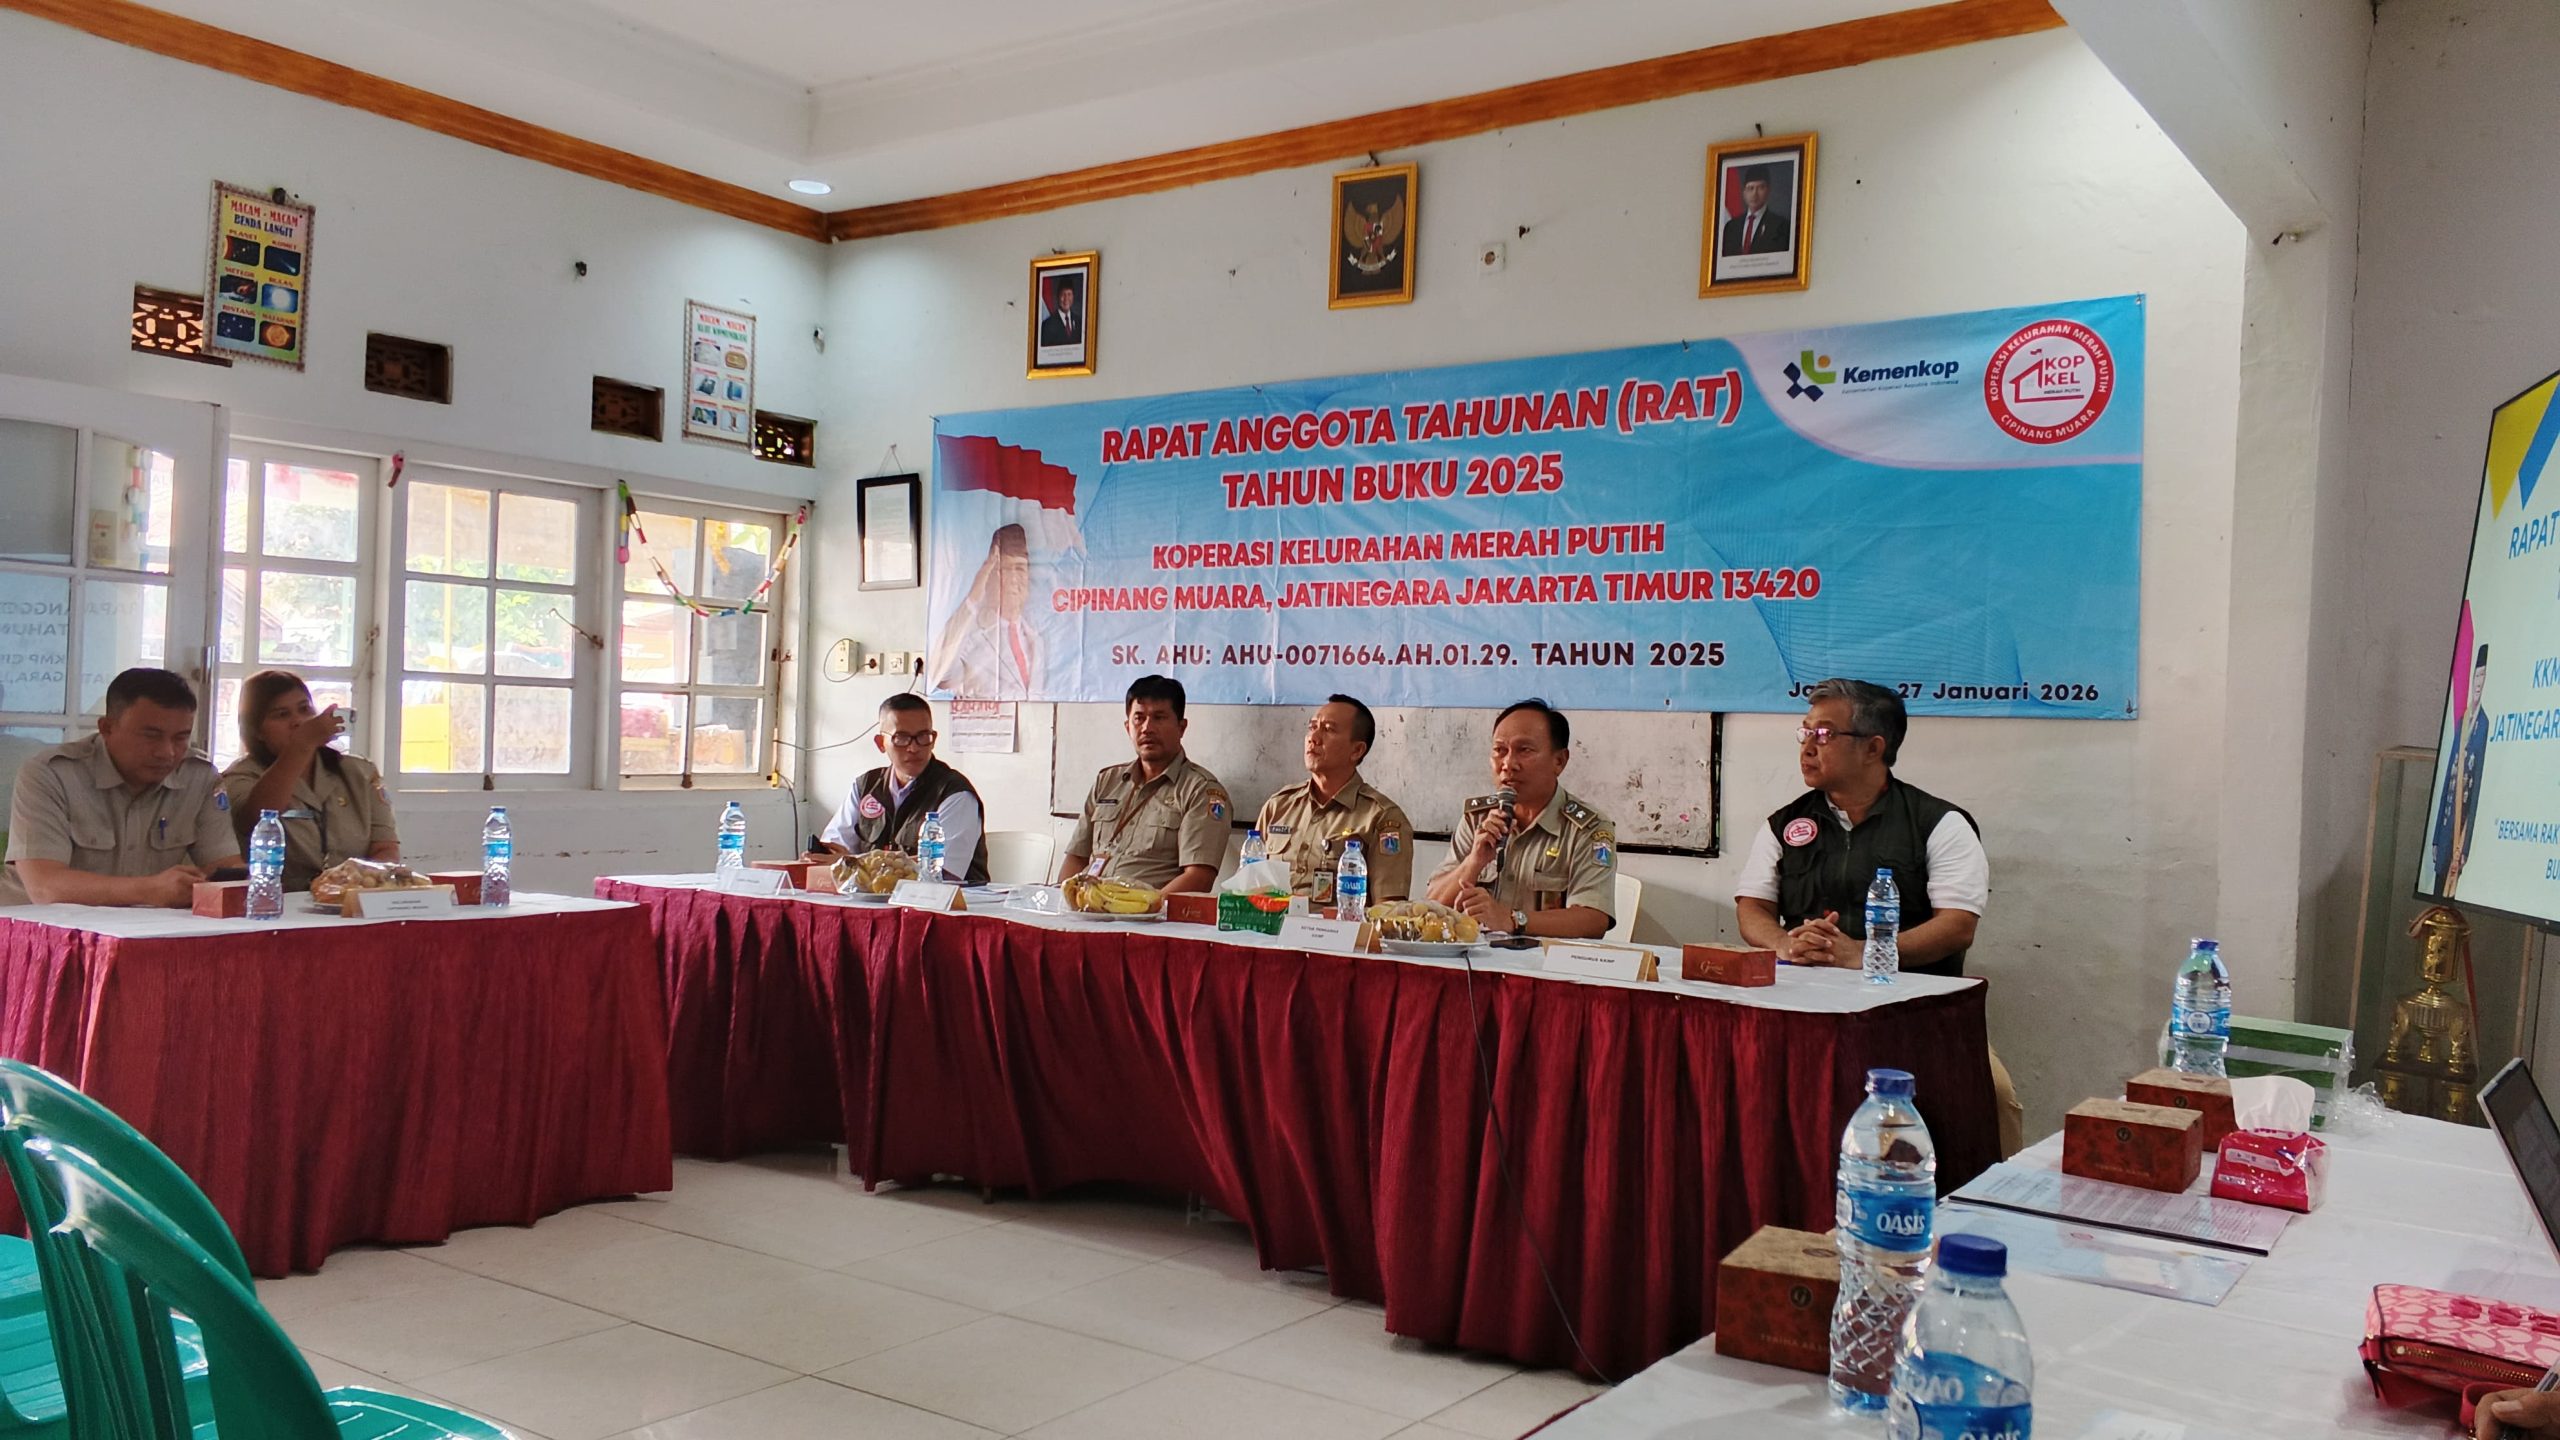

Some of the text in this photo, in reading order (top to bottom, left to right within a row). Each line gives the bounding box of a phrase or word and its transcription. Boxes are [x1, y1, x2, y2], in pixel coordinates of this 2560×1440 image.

[231, 200, 261, 217] MACAM
[270, 210, 298, 227] MACAM
[234, 213, 293, 238] BENDA LANGIT
[1843, 360, 1959, 384] Kemenkop
[1990, 324, 2109, 401] KOPERASI KELURAHAN MERAH PUTIH
[2045, 355, 2085, 370] KOP
[2044, 372, 2080, 386] KEL
[1102, 369, 1743, 463] RAPAT ANGGOTA TAHUNAN (RAT)
[2001, 408, 2095, 439] CIPINANG MUARA
[1222, 453, 1564, 509] TAHUN BUKU 2025
[1152, 523, 1665, 570] KOPERASI KELURAHAN MERAH PUTIH
[1052, 566, 1821, 613] CIPINANG MUARA, JATINEGARA JAKARTA TIMUR 13420
[1112, 641, 1726, 666] SK. AHU: AHU-0071664.AH.01.29. TAHUN 2025
[1897, 682, 2100, 701] 27 Januari 2026
[1876, 1210, 1926, 1236] OASIS
